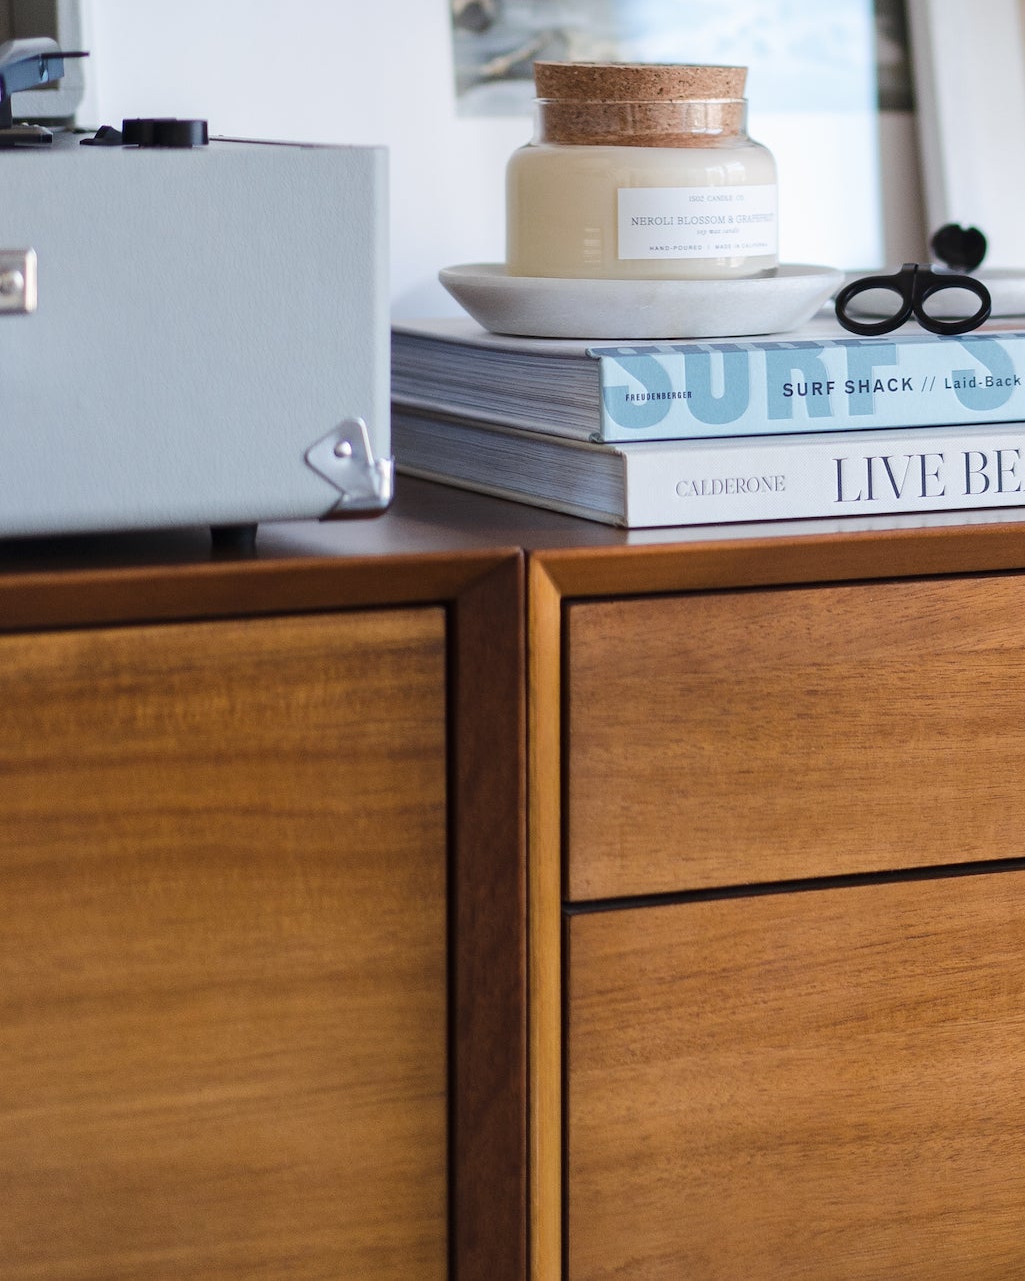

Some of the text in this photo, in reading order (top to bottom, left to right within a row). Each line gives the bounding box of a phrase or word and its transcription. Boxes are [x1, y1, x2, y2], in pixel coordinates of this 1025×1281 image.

[707, 194, 733, 202] CANDLE
[631, 216, 674, 226] NEROLI
[677, 215, 726, 225] BLOSSOM
[727, 215, 734, 224] &
[782, 381, 836, 397] SURF
[844, 377, 914, 395] SHACK
[944, 375, 1021, 390] Laid-Back
[625, 391, 693, 401] FREUDENBERGER
[832, 453, 946, 503] LIVE
[675, 475, 786, 498] CALDERONE
